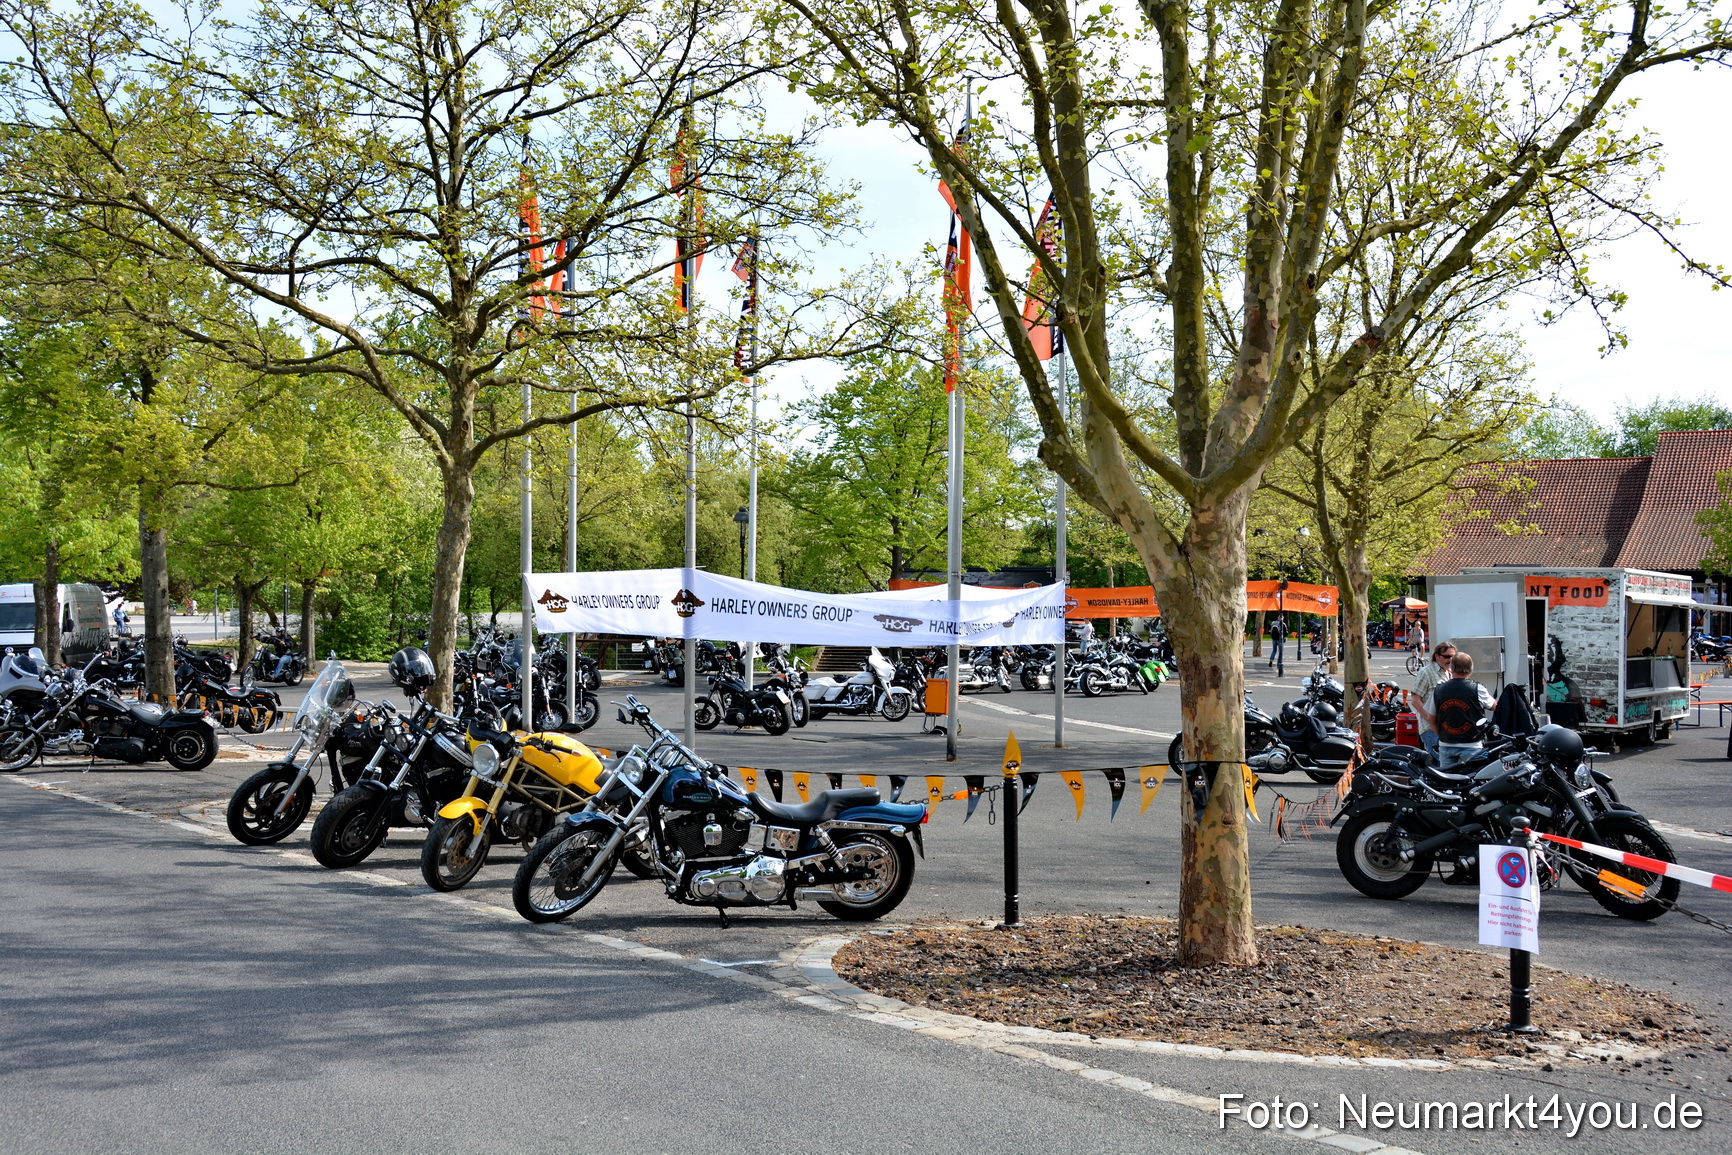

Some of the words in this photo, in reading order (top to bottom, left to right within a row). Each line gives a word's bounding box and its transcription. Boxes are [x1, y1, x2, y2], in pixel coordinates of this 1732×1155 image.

[1525, 585, 1552, 597] NT
[1559, 585, 1604, 599] FOOD
[571, 595, 601, 609] HARLEY
[601, 594, 634, 609] OWNERS
[635, 594, 661, 609] GROUP
[711, 597, 757, 615] HARLEY
[757, 600, 808, 619] OWNERS
[812, 605, 853, 623] GROUP
[1020, 606, 1044, 621] HARLEY
[884, 618, 911, 631] HOG
